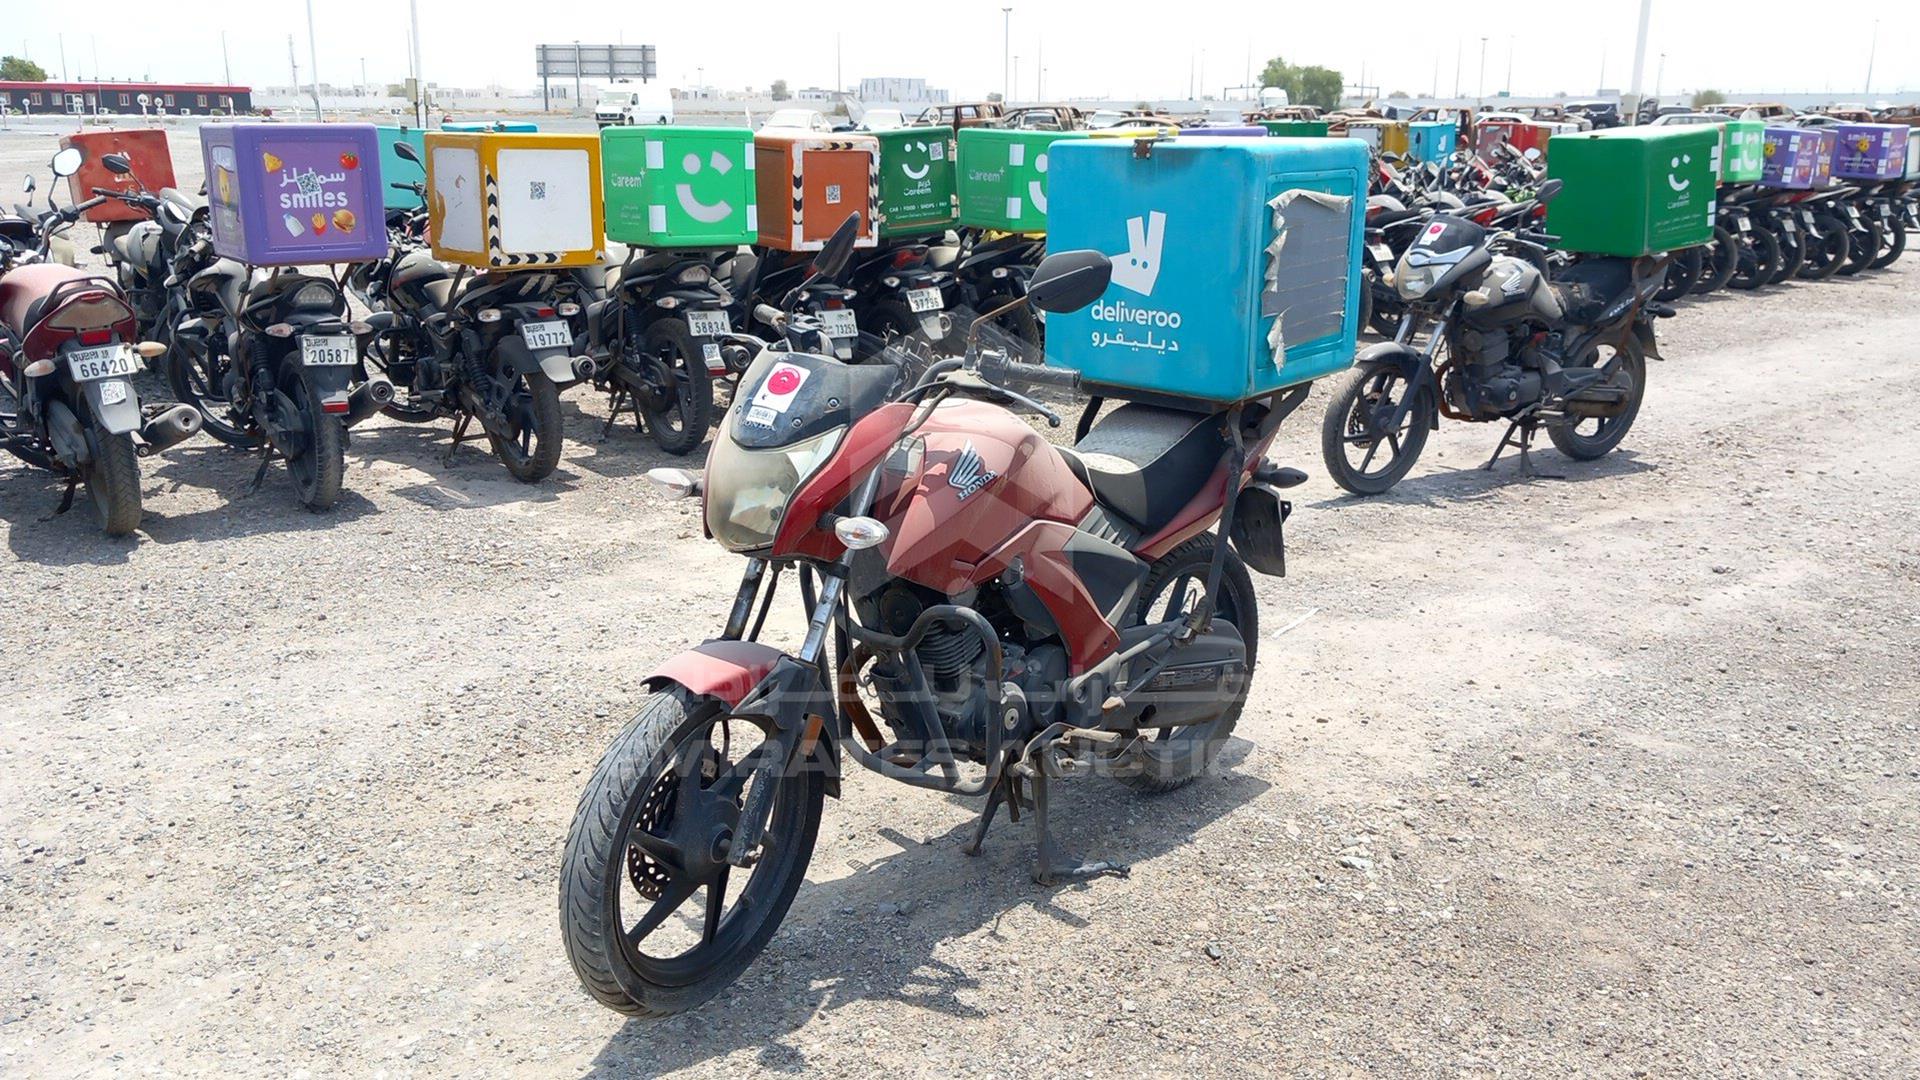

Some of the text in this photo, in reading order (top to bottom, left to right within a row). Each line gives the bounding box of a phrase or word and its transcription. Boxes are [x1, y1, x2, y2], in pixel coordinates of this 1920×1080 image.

[280, 191, 348, 209] smiles
[1091, 299, 1181, 328] deliveroo
[695, 321, 726, 334] 58834
[532, 331, 568, 347] 19772
[1091, 328, 1179, 355] ديليفرو
[310, 348, 350, 364] 20587
[80, 358, 129, 378] 66420
[957, 470, 998, 501] HONDA
